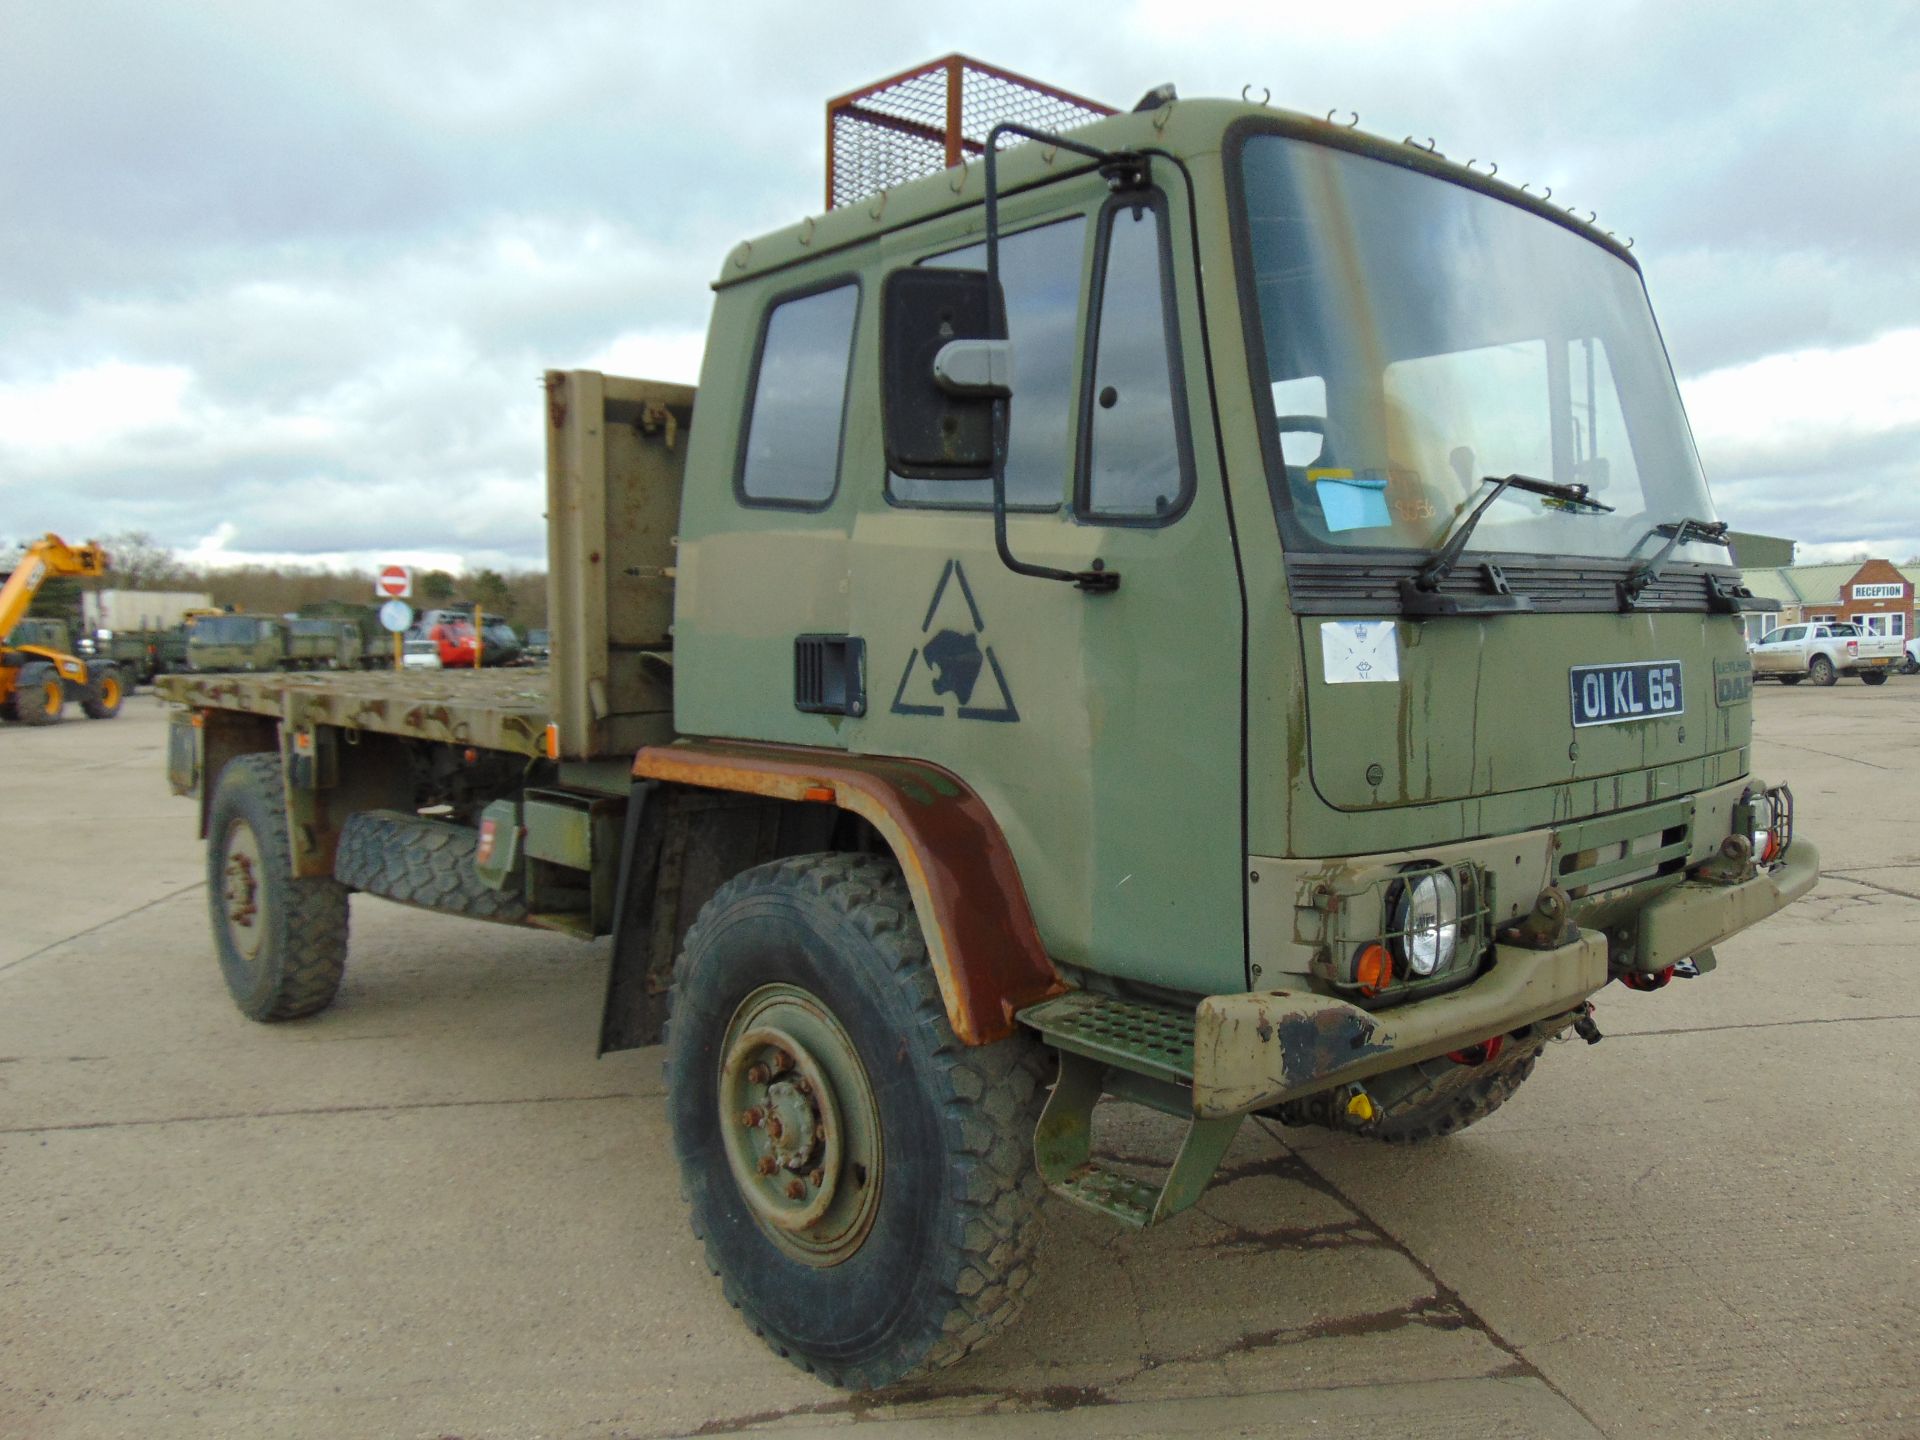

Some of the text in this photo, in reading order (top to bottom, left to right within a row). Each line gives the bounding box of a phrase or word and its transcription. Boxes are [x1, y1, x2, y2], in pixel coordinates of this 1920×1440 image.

[1855, 586, 1901, 597] RECEPTION
[1613, 671, 1643, 714] KL
[1648, 668, 1675, 710] 65
